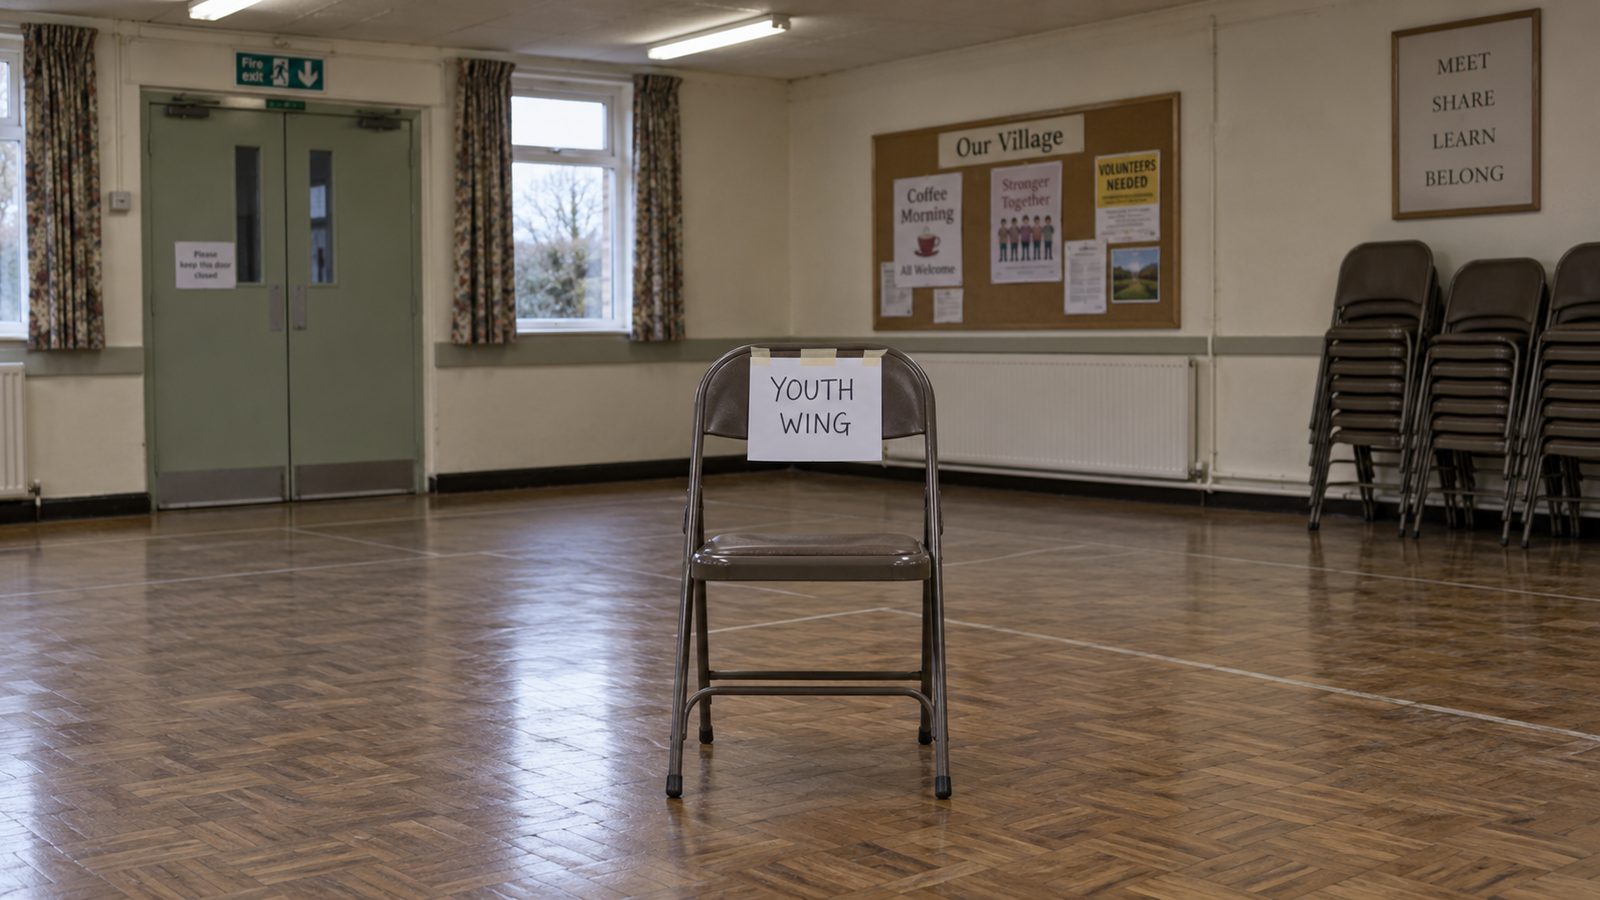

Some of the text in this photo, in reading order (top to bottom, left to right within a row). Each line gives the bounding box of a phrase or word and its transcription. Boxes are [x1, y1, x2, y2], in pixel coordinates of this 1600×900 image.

[242, 57, 263, 69] Fire
[1437, 51, 1491, 75] MEET
[242, 71, 264, 82] exit
[1432, 90, 1496, 113] SHARE
[956, 128, 1064, 158] Our Village
[1433, 127, 1496, 150] LEARN
[1099, 159, 1157, 177] VOLUNTEERS
[1425, 165, 1504, 187] BELONG
[1002, 176, 1050, 193] Stronger
[1107, 175, 1148, 191] NEEDED
[907, 186, 948, 204] Coffee
[1001, 193, 1051, 212] Together
[901, 206, 955, 226] Morning
[193, 250, 218, 258] Please
[180, 261, 232, 270] keep this door
[900, 263, 955, 276] All Welcome
[770, 376, 853, 402] YOUTH
[780, 411, 851, 436] WING
